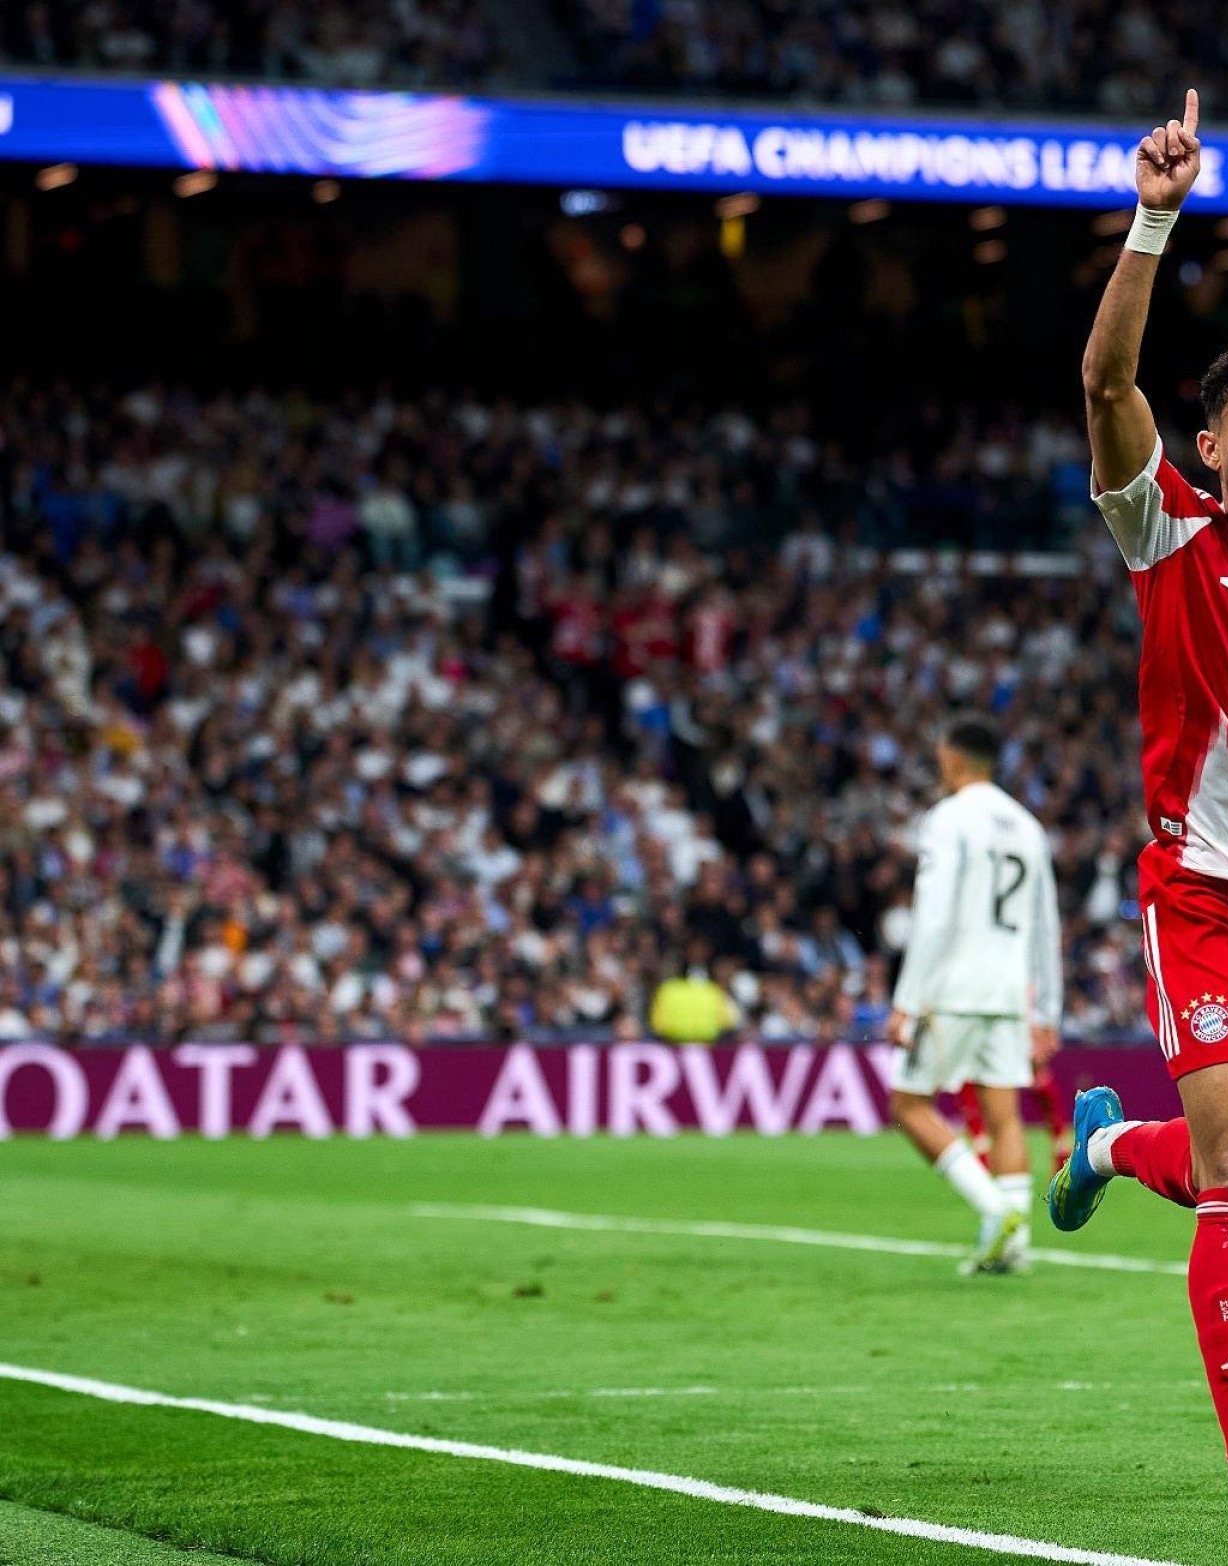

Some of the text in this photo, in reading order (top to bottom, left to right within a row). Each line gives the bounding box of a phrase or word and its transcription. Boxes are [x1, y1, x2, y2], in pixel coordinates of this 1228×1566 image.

[622, 122, 1225, 197] UEFA CHAMPIONS LEAE
[476, 1042, 893, 1139] AIRWA
